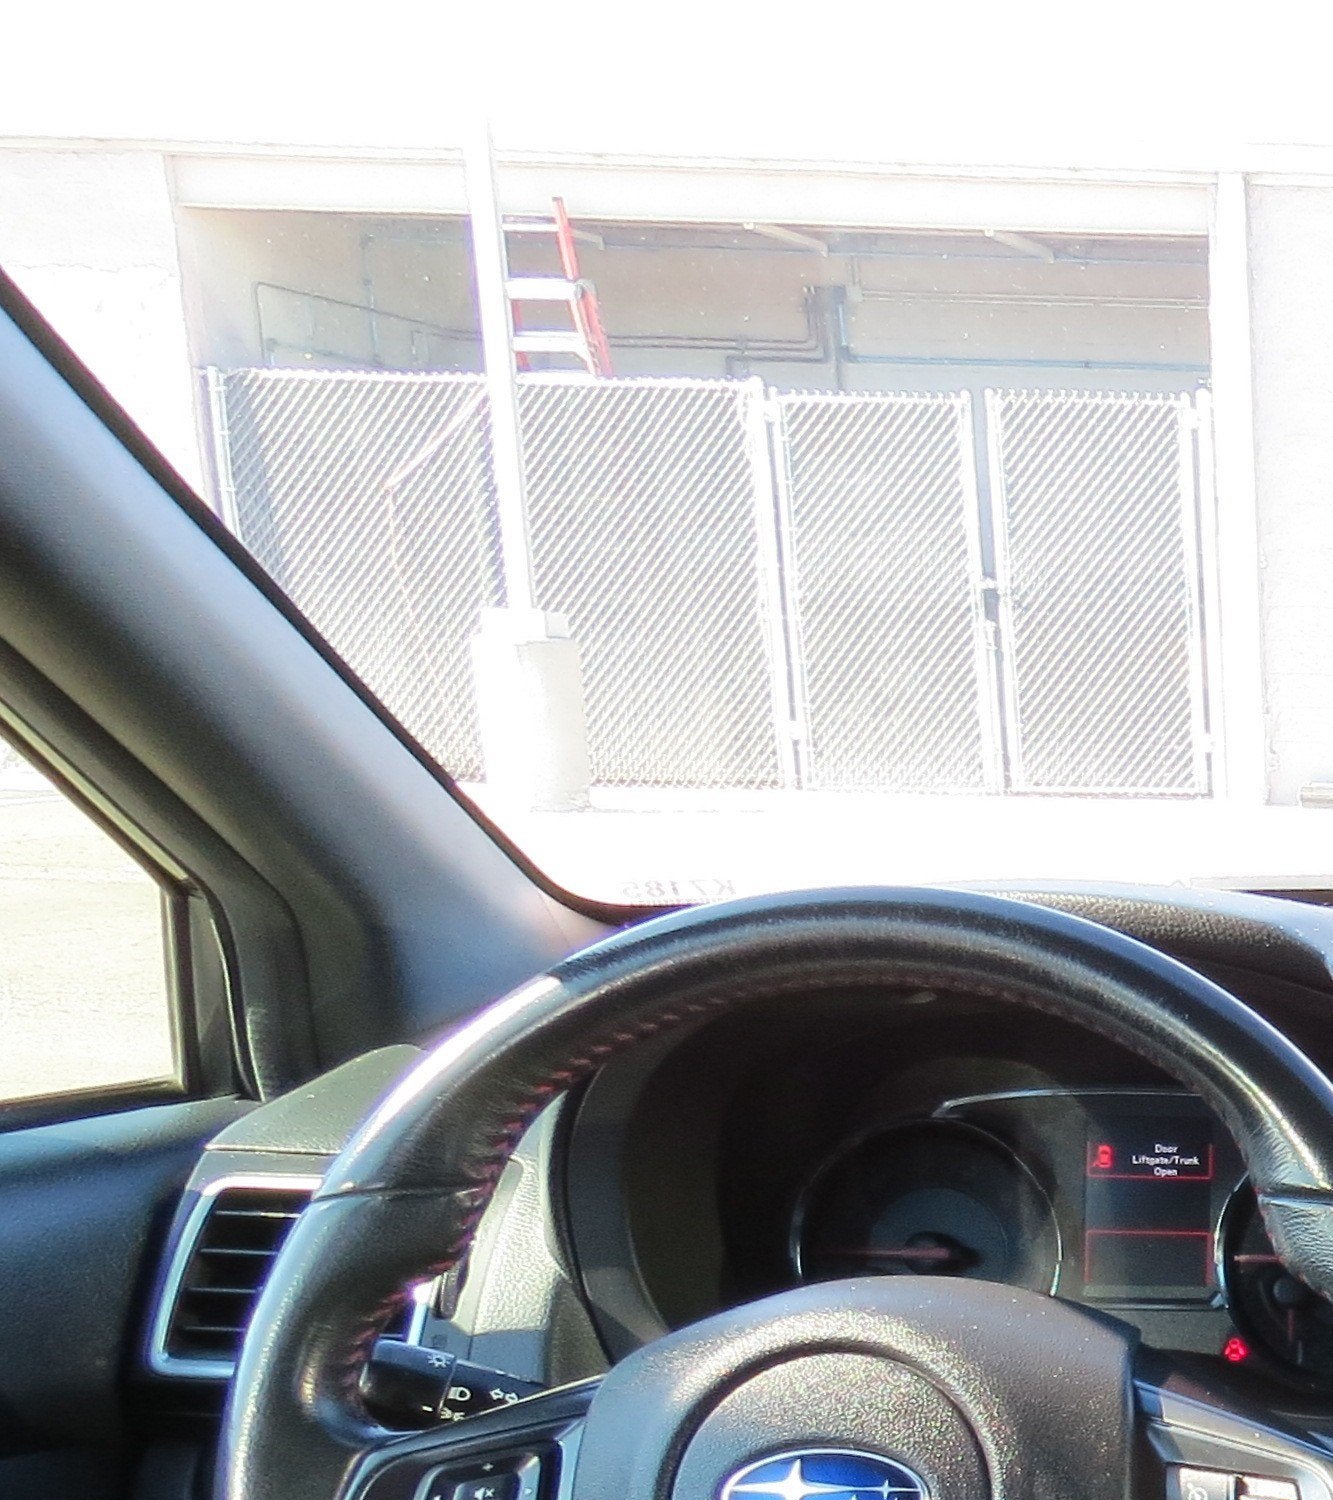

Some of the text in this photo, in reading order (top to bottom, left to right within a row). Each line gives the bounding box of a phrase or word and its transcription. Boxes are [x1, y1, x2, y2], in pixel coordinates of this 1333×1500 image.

[1154, 1143, 1180, 1153] Door
[1131, 1154, 1201, 1167] Liftgate/Trunk
[1153, 1166, 1178, 1177] Open
